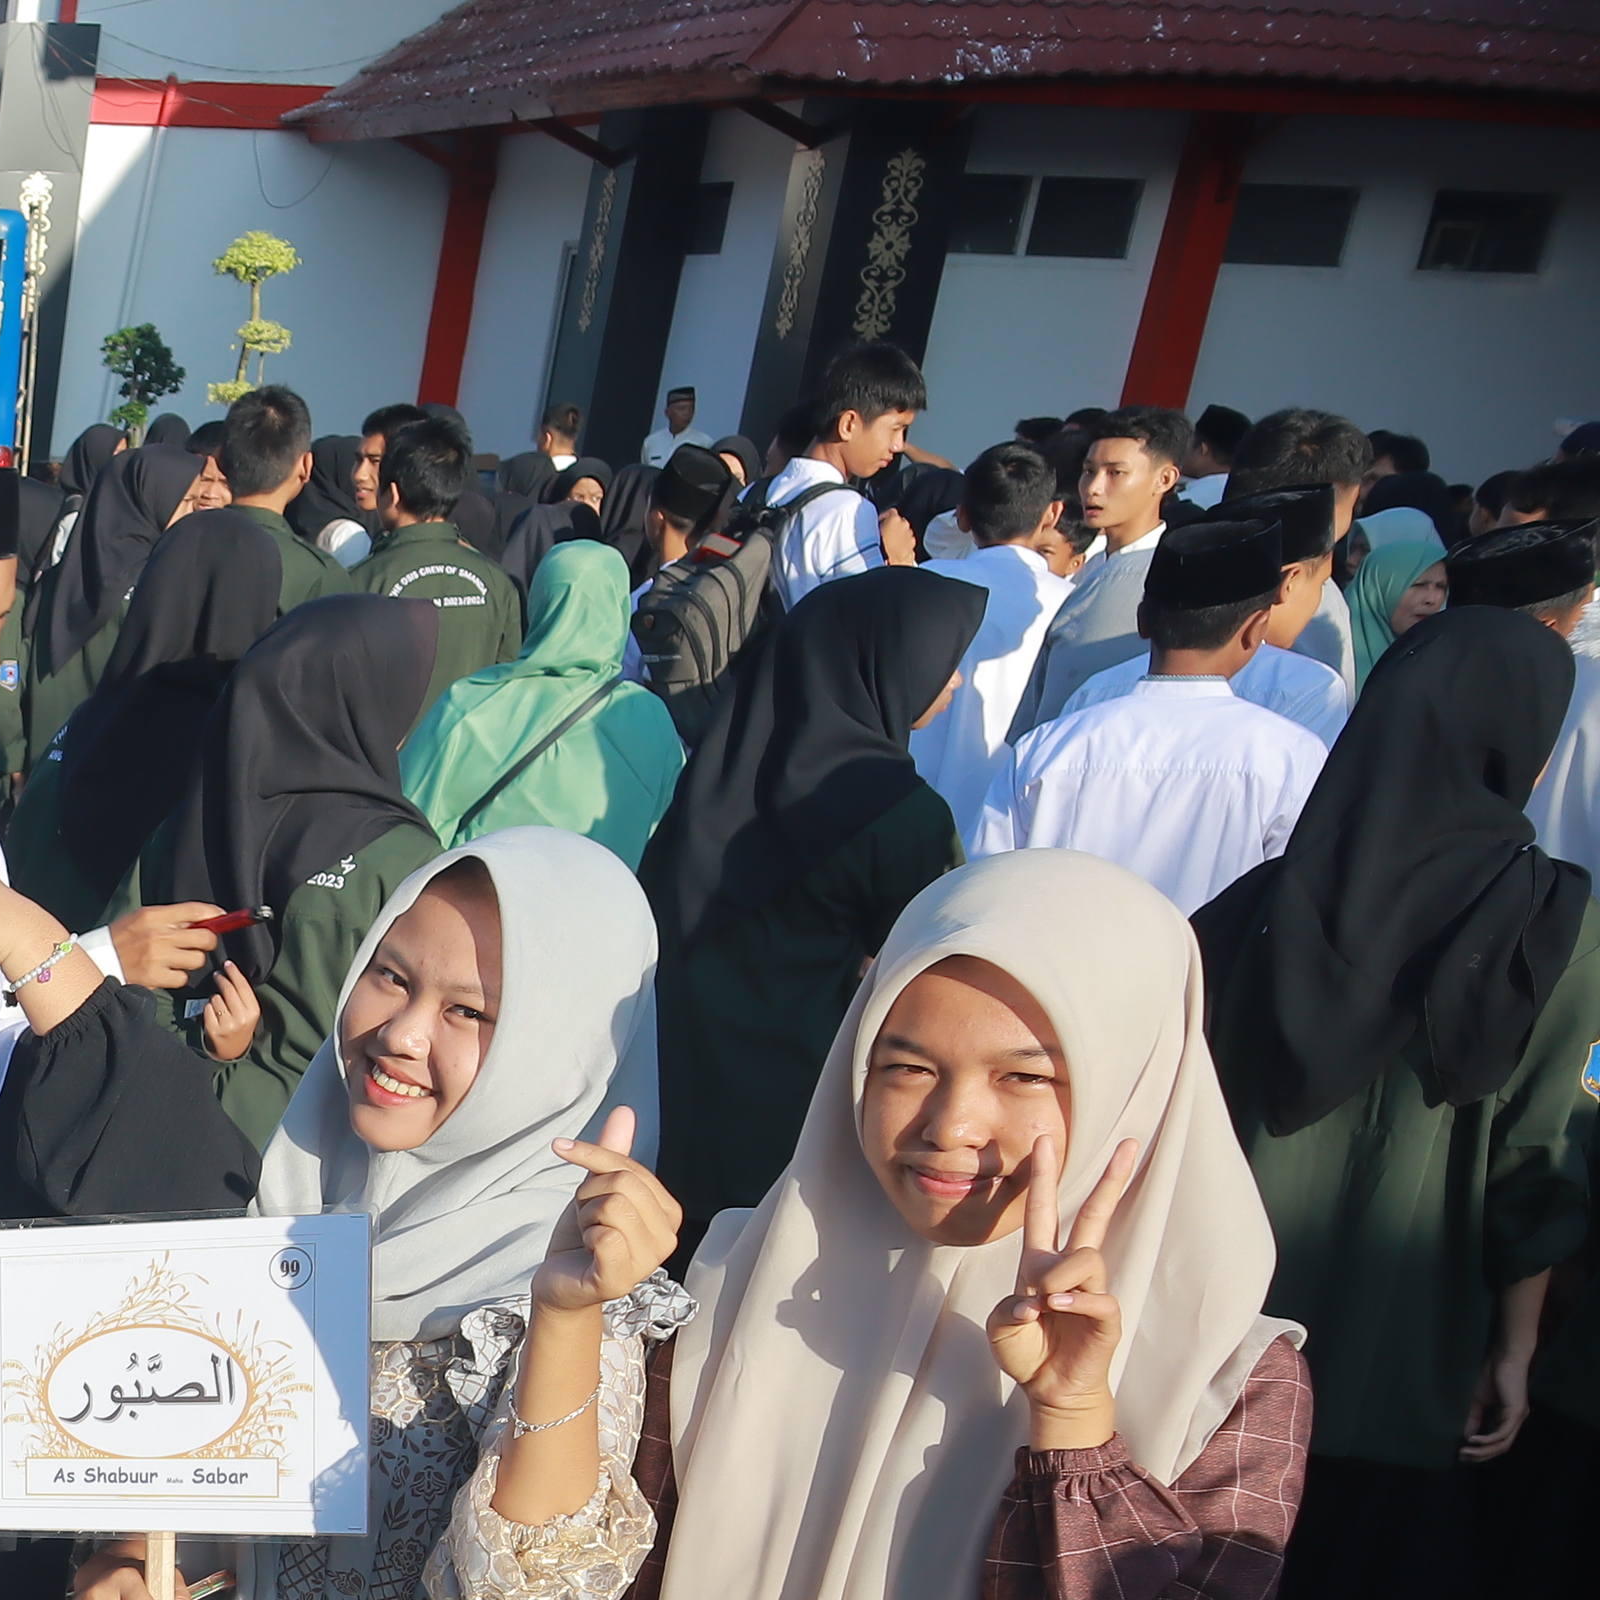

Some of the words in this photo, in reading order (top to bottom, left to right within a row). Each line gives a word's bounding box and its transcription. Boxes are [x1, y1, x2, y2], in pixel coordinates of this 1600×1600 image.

[400, 570, 420, 586] OSIS
[419, 564, 445, 577] CREW
[445, 564, 458, 576] OF
[458, 567, 489, 596] SMANDA
[443, 596, 486, 607] 2023/2024
[279, 1258, 302, 1279] 99
[53, 1467, 76, 1484] As
[84, 1466, 160, 1484] Shabuur
[166, 1476, 184, 1485] Maha
[191, 1467, 249, 1485] Sabar
